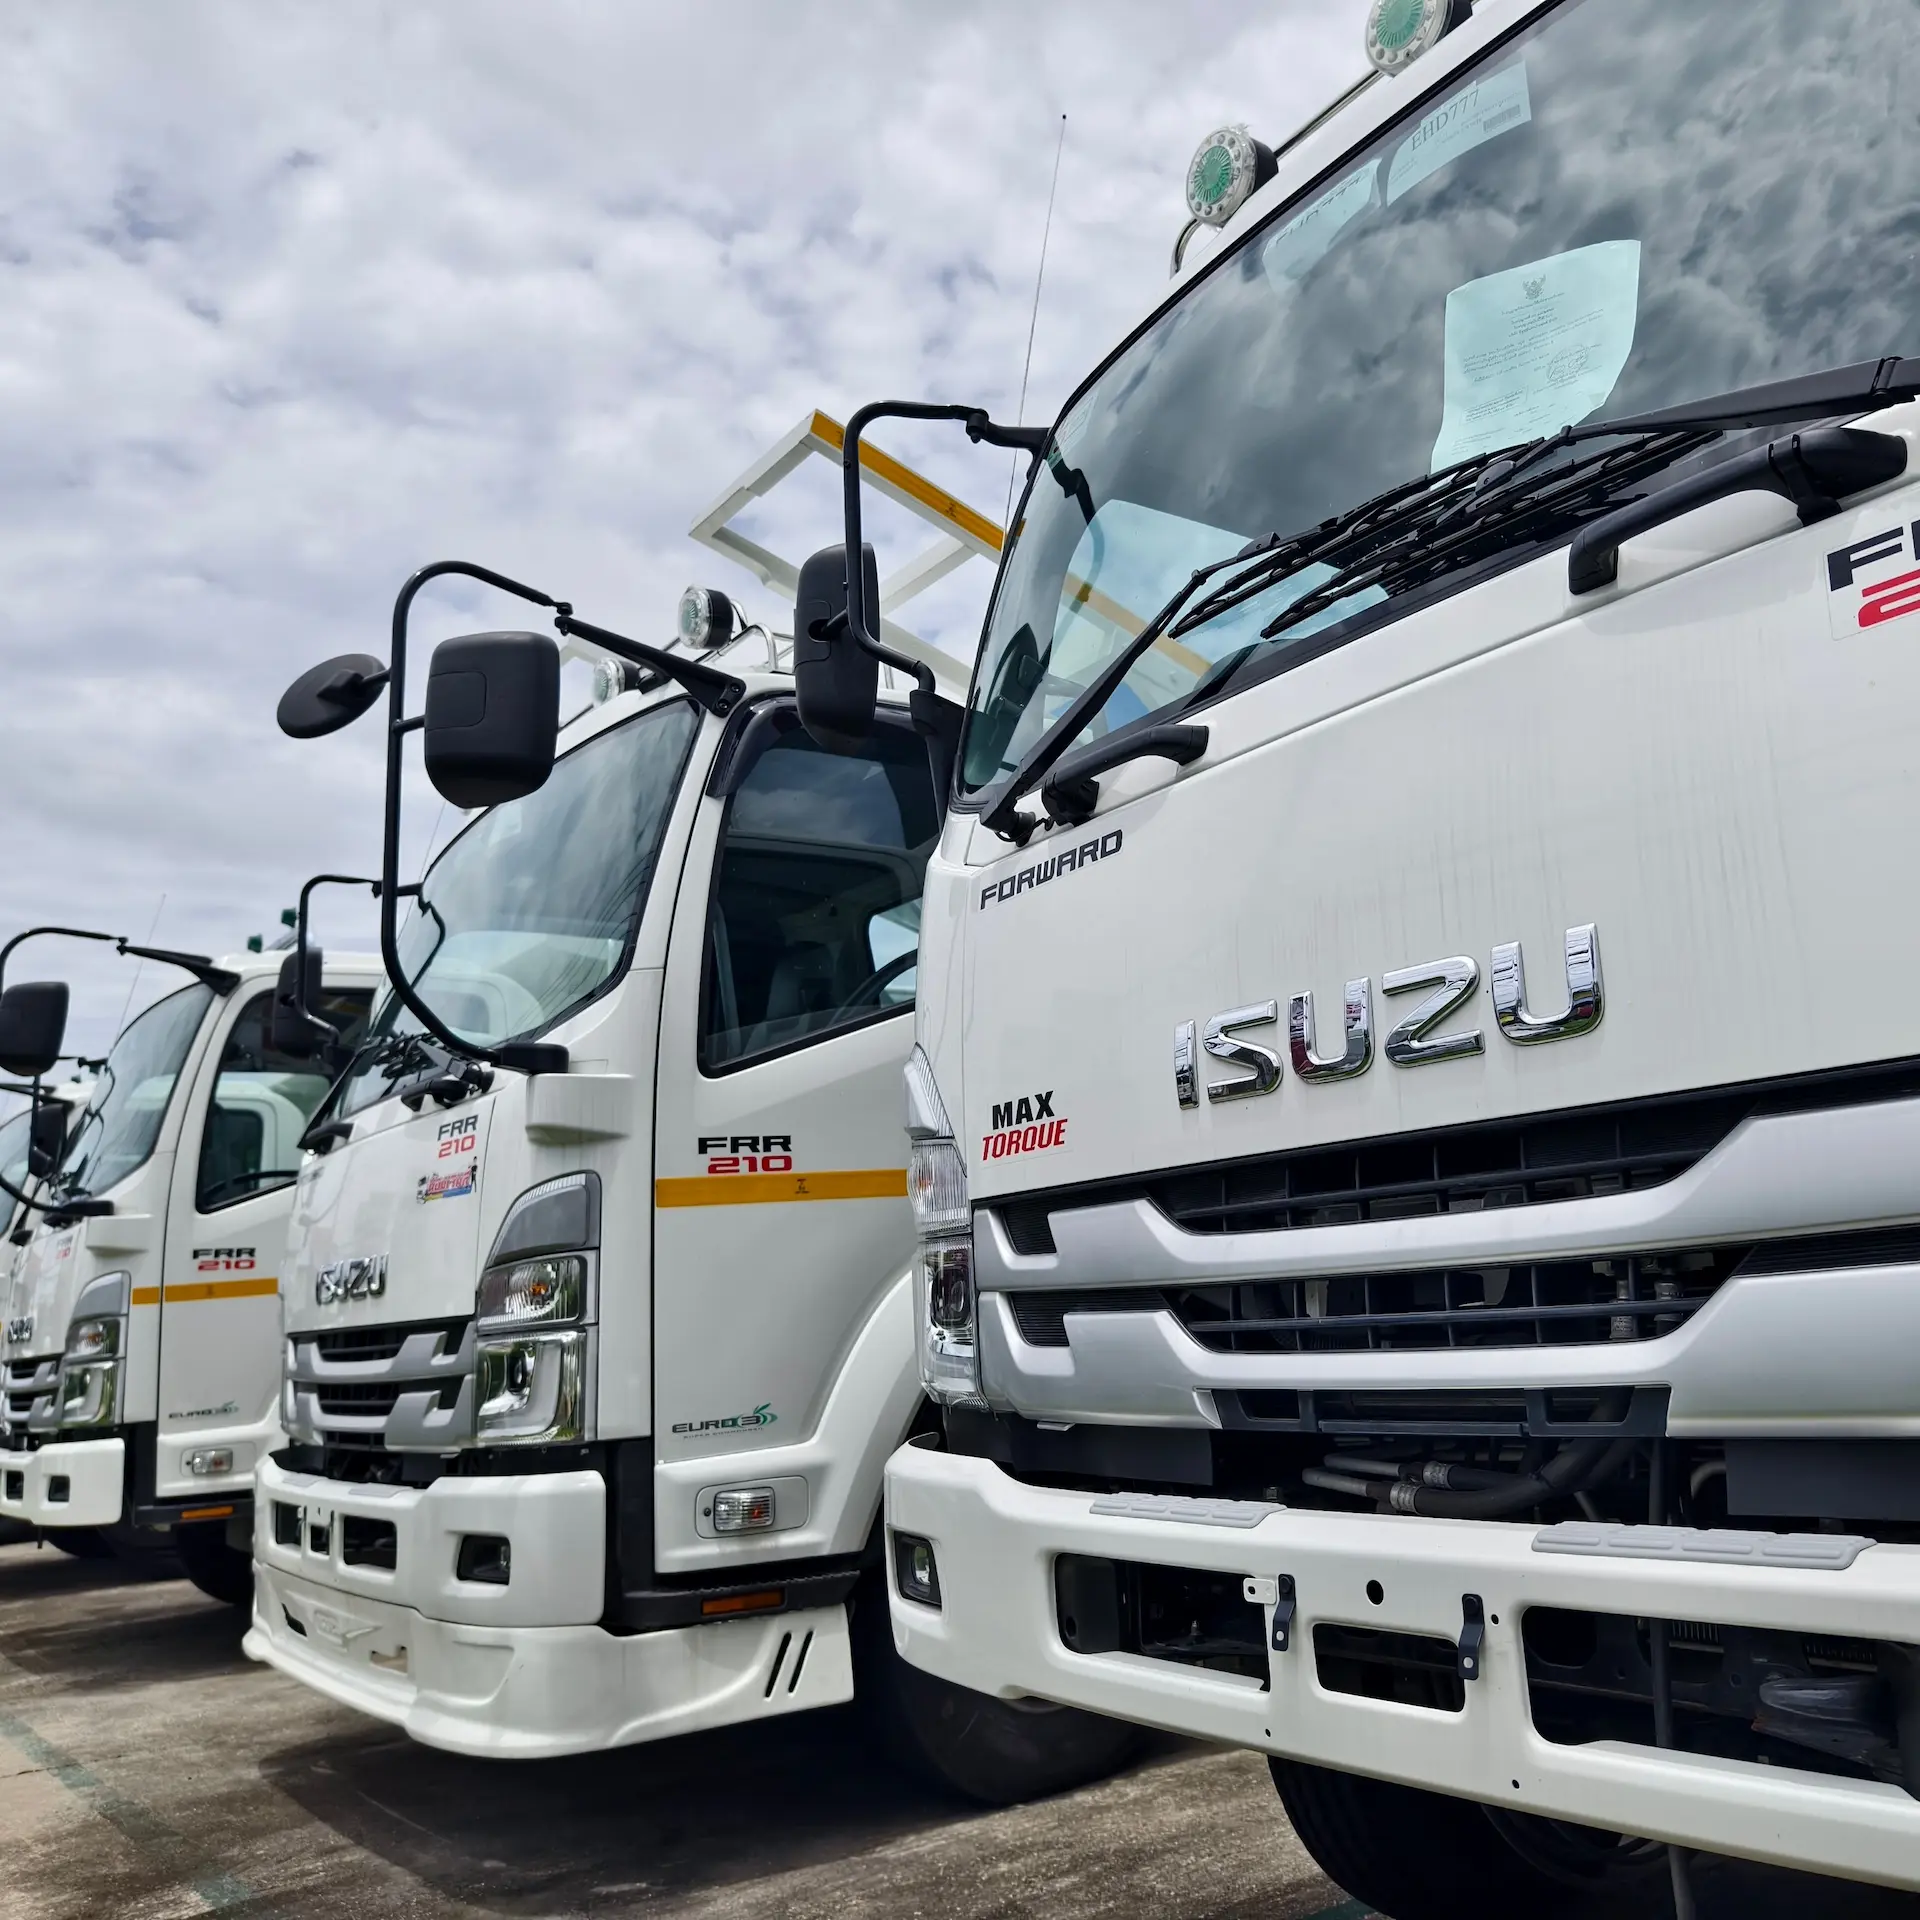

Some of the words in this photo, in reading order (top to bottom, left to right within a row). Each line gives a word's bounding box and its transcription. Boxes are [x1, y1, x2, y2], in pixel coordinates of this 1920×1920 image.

[1411, 88, 1480, 151] EHD777
[1827, 522, 1920, 592] F
[980, 829, 1123, 910] FORWARD
[1174, 922, 1605, 1110] ISUZU
[437, 1114, 478, 1142] FRR
[992, 1090, 1055, 1130] MAX
[438, 1134, 476, 1158] 210
[697, 1135, 792, 1154] FRR
[982, 1118, 1068, 1162] TORQUE
[707, 1155, 792, 1174] 210
[192, 1247, 256, 1260] FRR
[197, 1259, 255, 1271] 210
[316, 1251, 389, 1306] ISUZU
